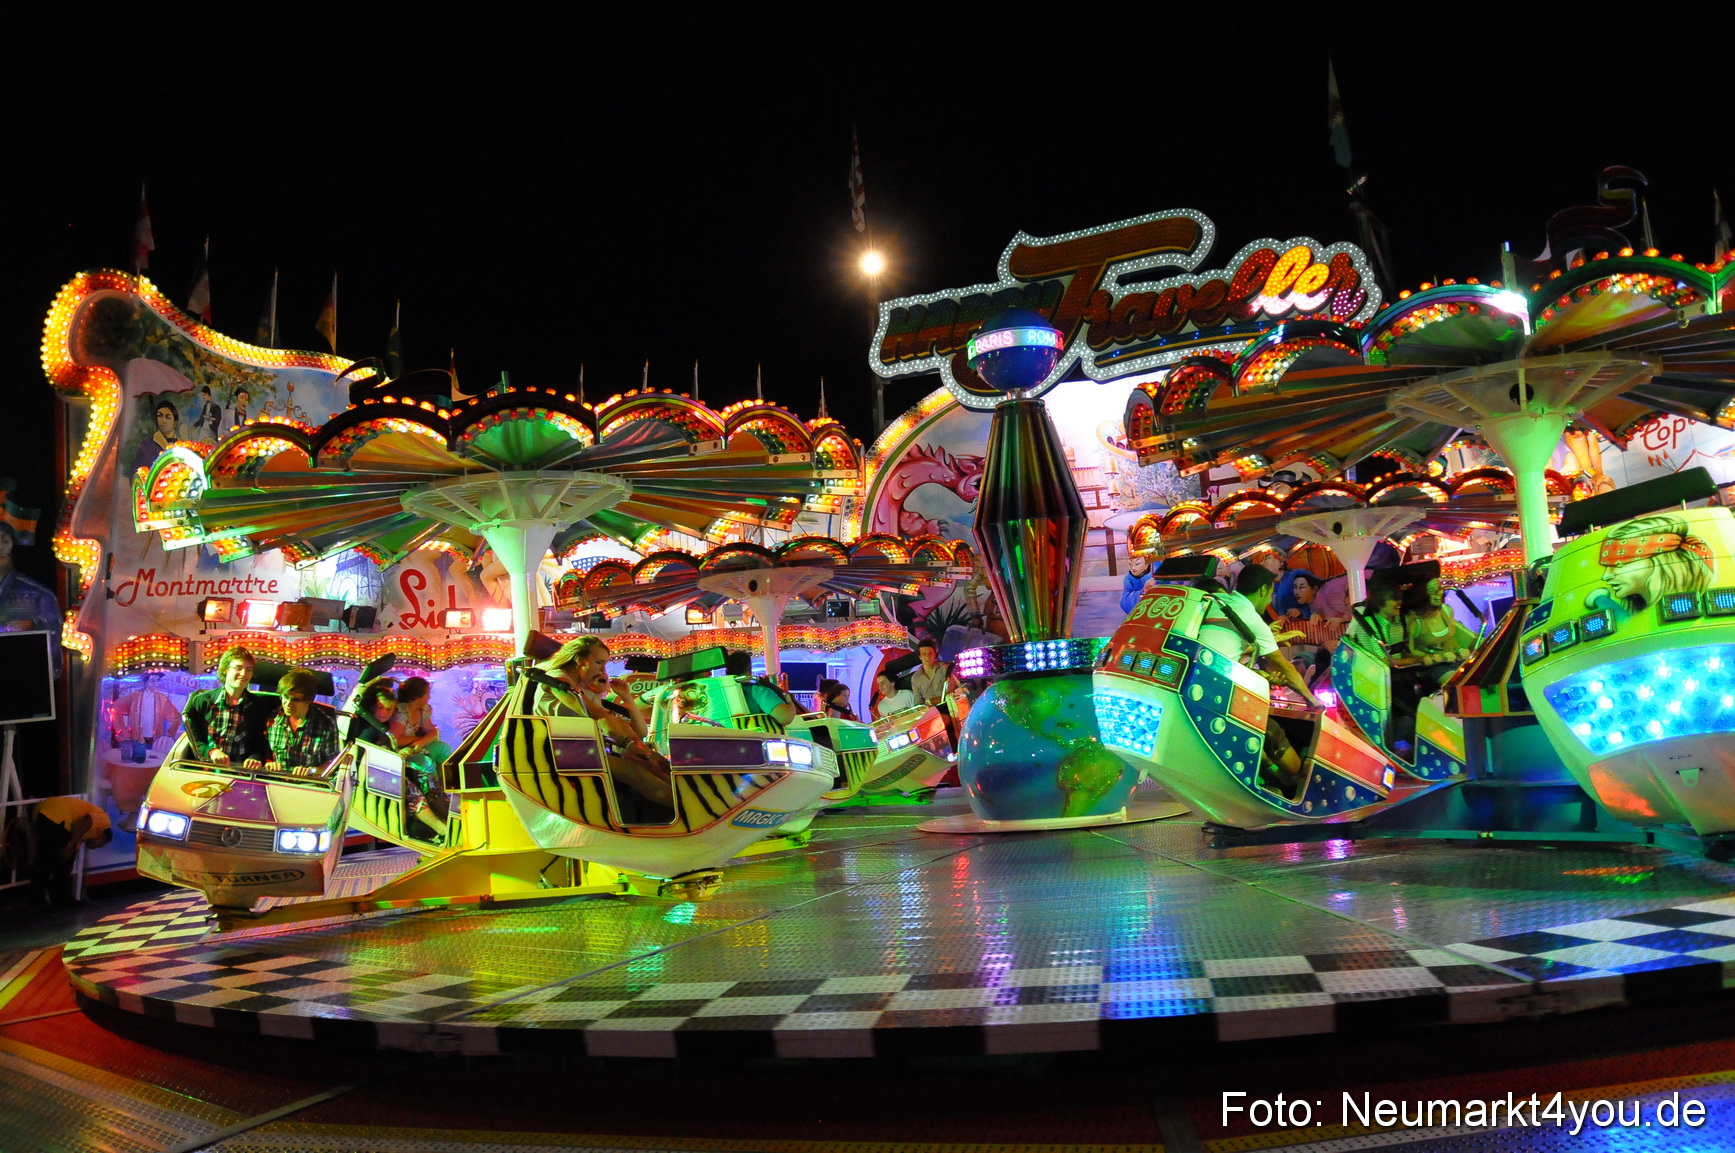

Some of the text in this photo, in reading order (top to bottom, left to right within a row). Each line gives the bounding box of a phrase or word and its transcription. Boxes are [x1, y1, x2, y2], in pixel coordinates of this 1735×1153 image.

[951, 217, 1366, 393] Traveller
[975, 331, 1013, 354] PARIS
[1640, 417, 1697, 451] Cop
[115, 568, 279, 607] Montmartre
[399, 568, 476, 630] Lid
